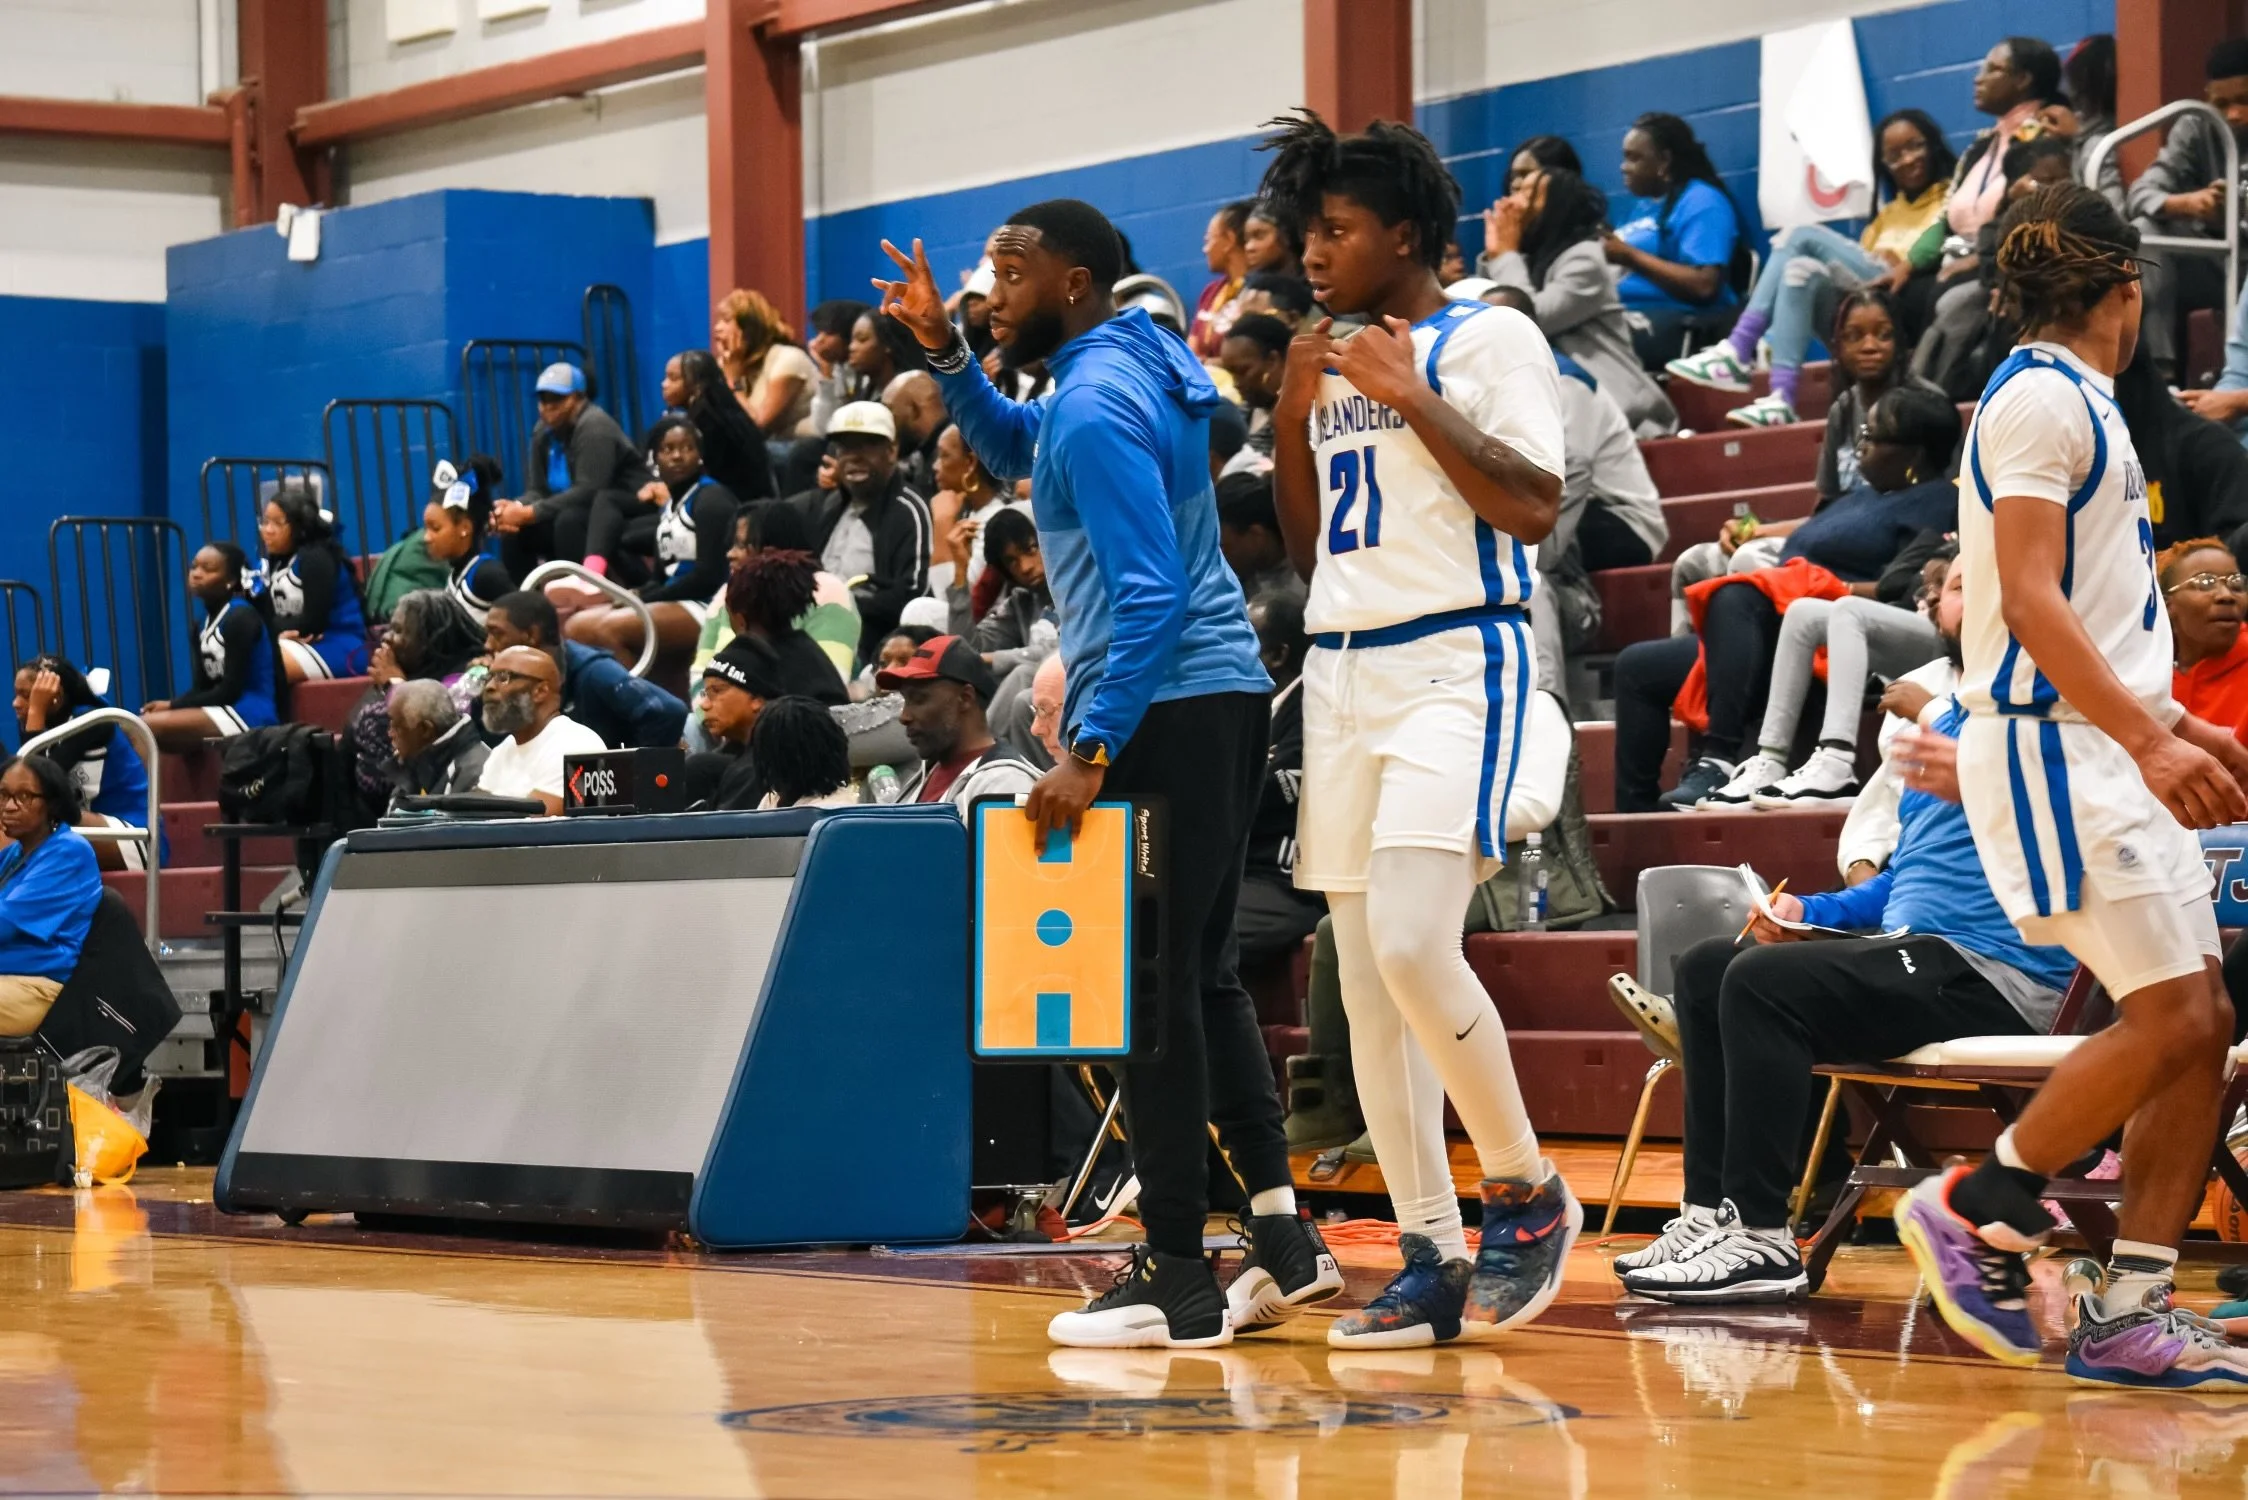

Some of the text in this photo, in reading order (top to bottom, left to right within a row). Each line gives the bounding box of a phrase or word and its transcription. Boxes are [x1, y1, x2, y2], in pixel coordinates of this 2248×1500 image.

[1328, 445, 1383, 555] 21
[584, 769, 617, 797] POSS.
[1138, 808, 1150, 841] Sport
[1897, 949, 1917, 974] FILA
[1322, 1259, 1335, 1271] 23
